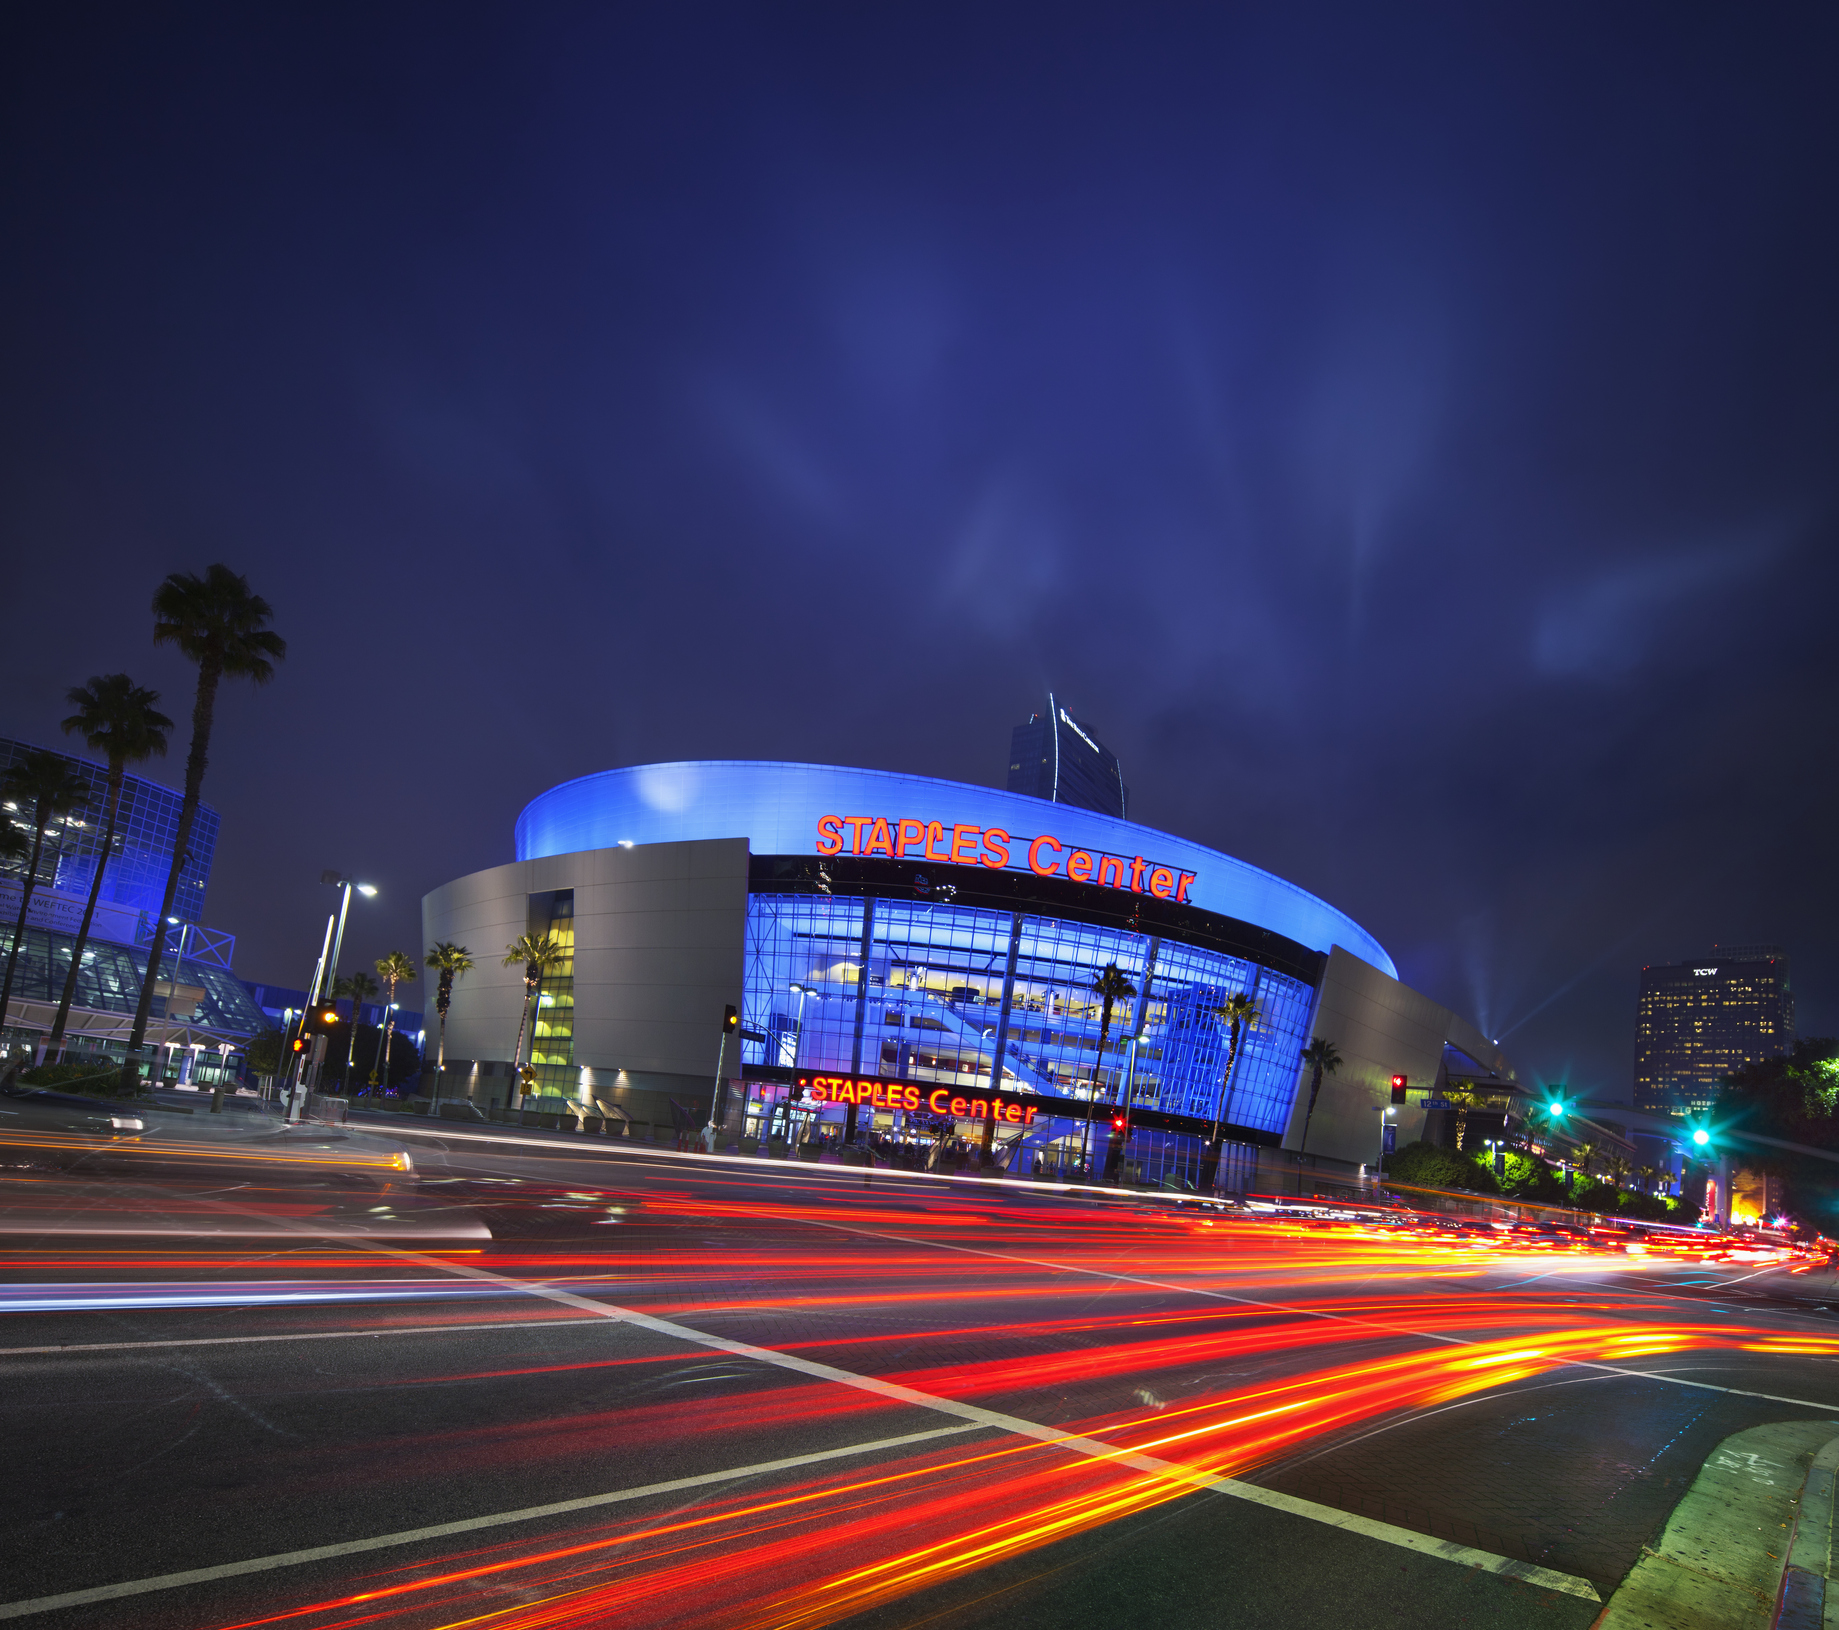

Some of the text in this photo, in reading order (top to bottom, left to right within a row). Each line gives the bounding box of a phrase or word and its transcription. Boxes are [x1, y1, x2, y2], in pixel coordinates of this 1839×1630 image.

[816, 815, 1195, 902] STAPLES Center
[33, 898, 75, 914] WEFTEC
[1693, 967, 1718, 976] TCW
[811, 1076, 921, 1111] STAPLES
[929, 1089, 1039, 1125] Center
[1423, 1100, 1438, 1108] 12th
